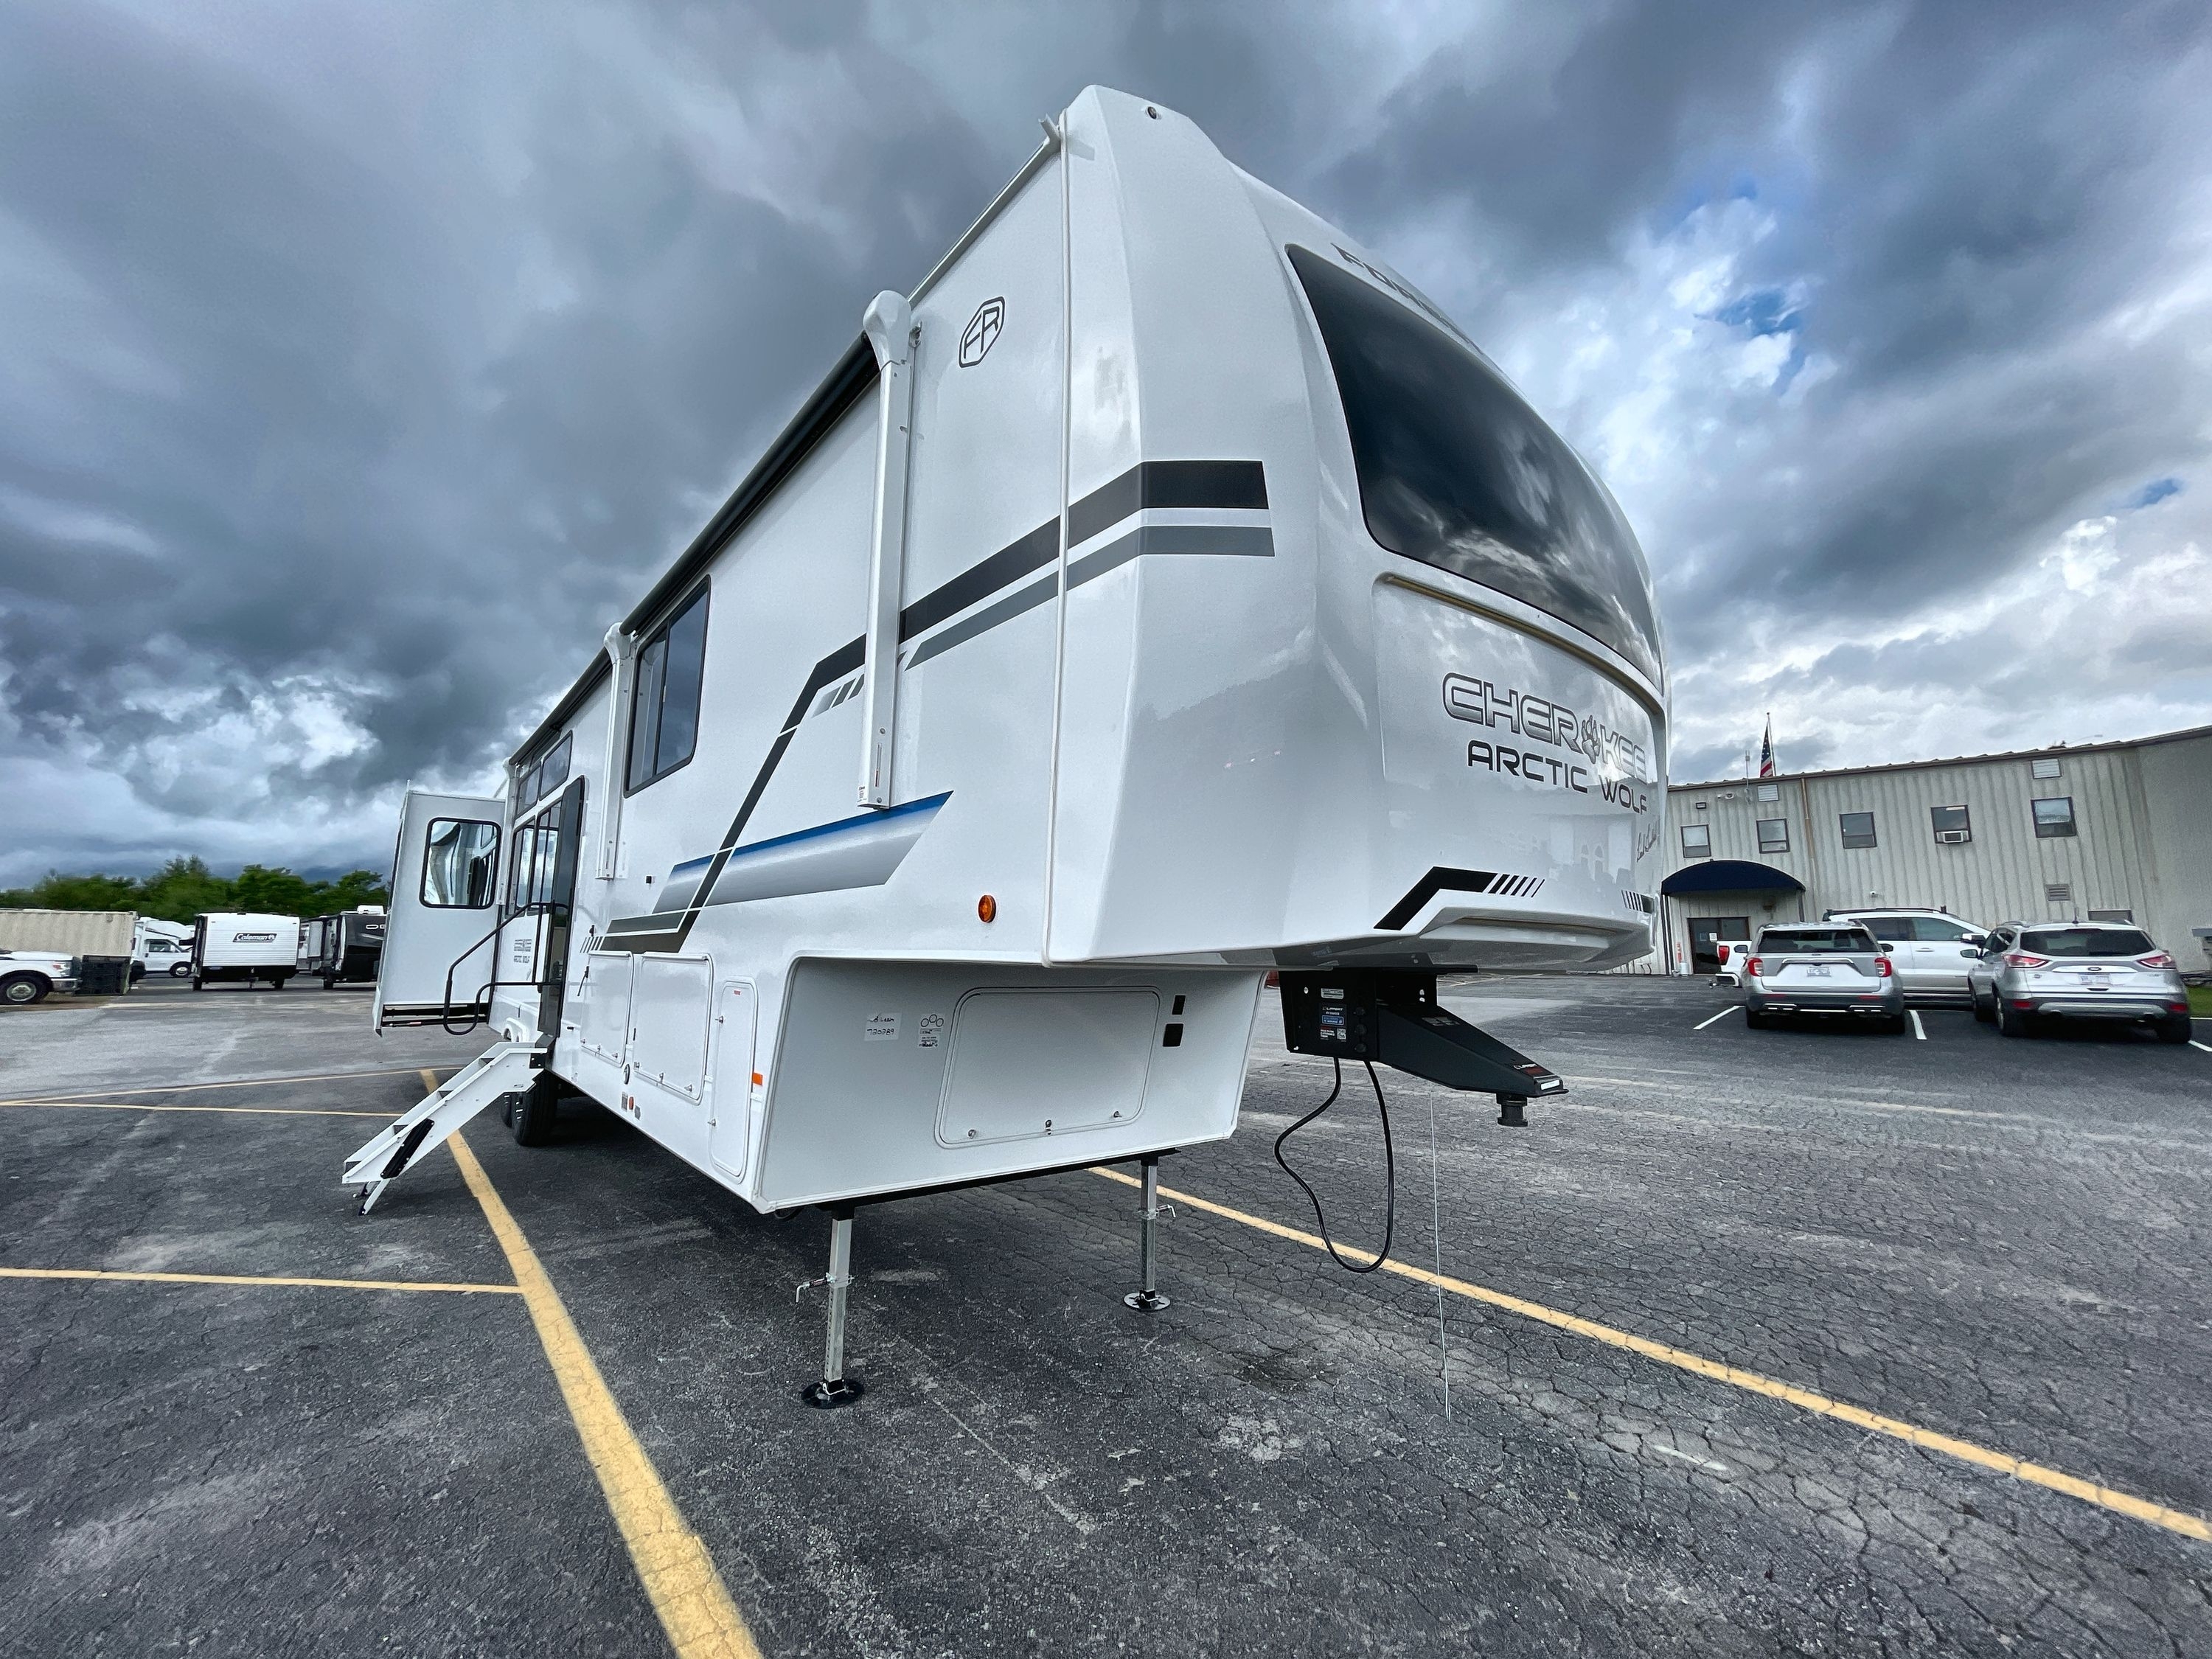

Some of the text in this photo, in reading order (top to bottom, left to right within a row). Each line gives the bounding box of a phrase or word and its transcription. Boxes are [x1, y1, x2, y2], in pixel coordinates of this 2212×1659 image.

[1467, 740, 1647, 815] ARCTIC WOLF
[236, 933, 268, 942] Coleman
